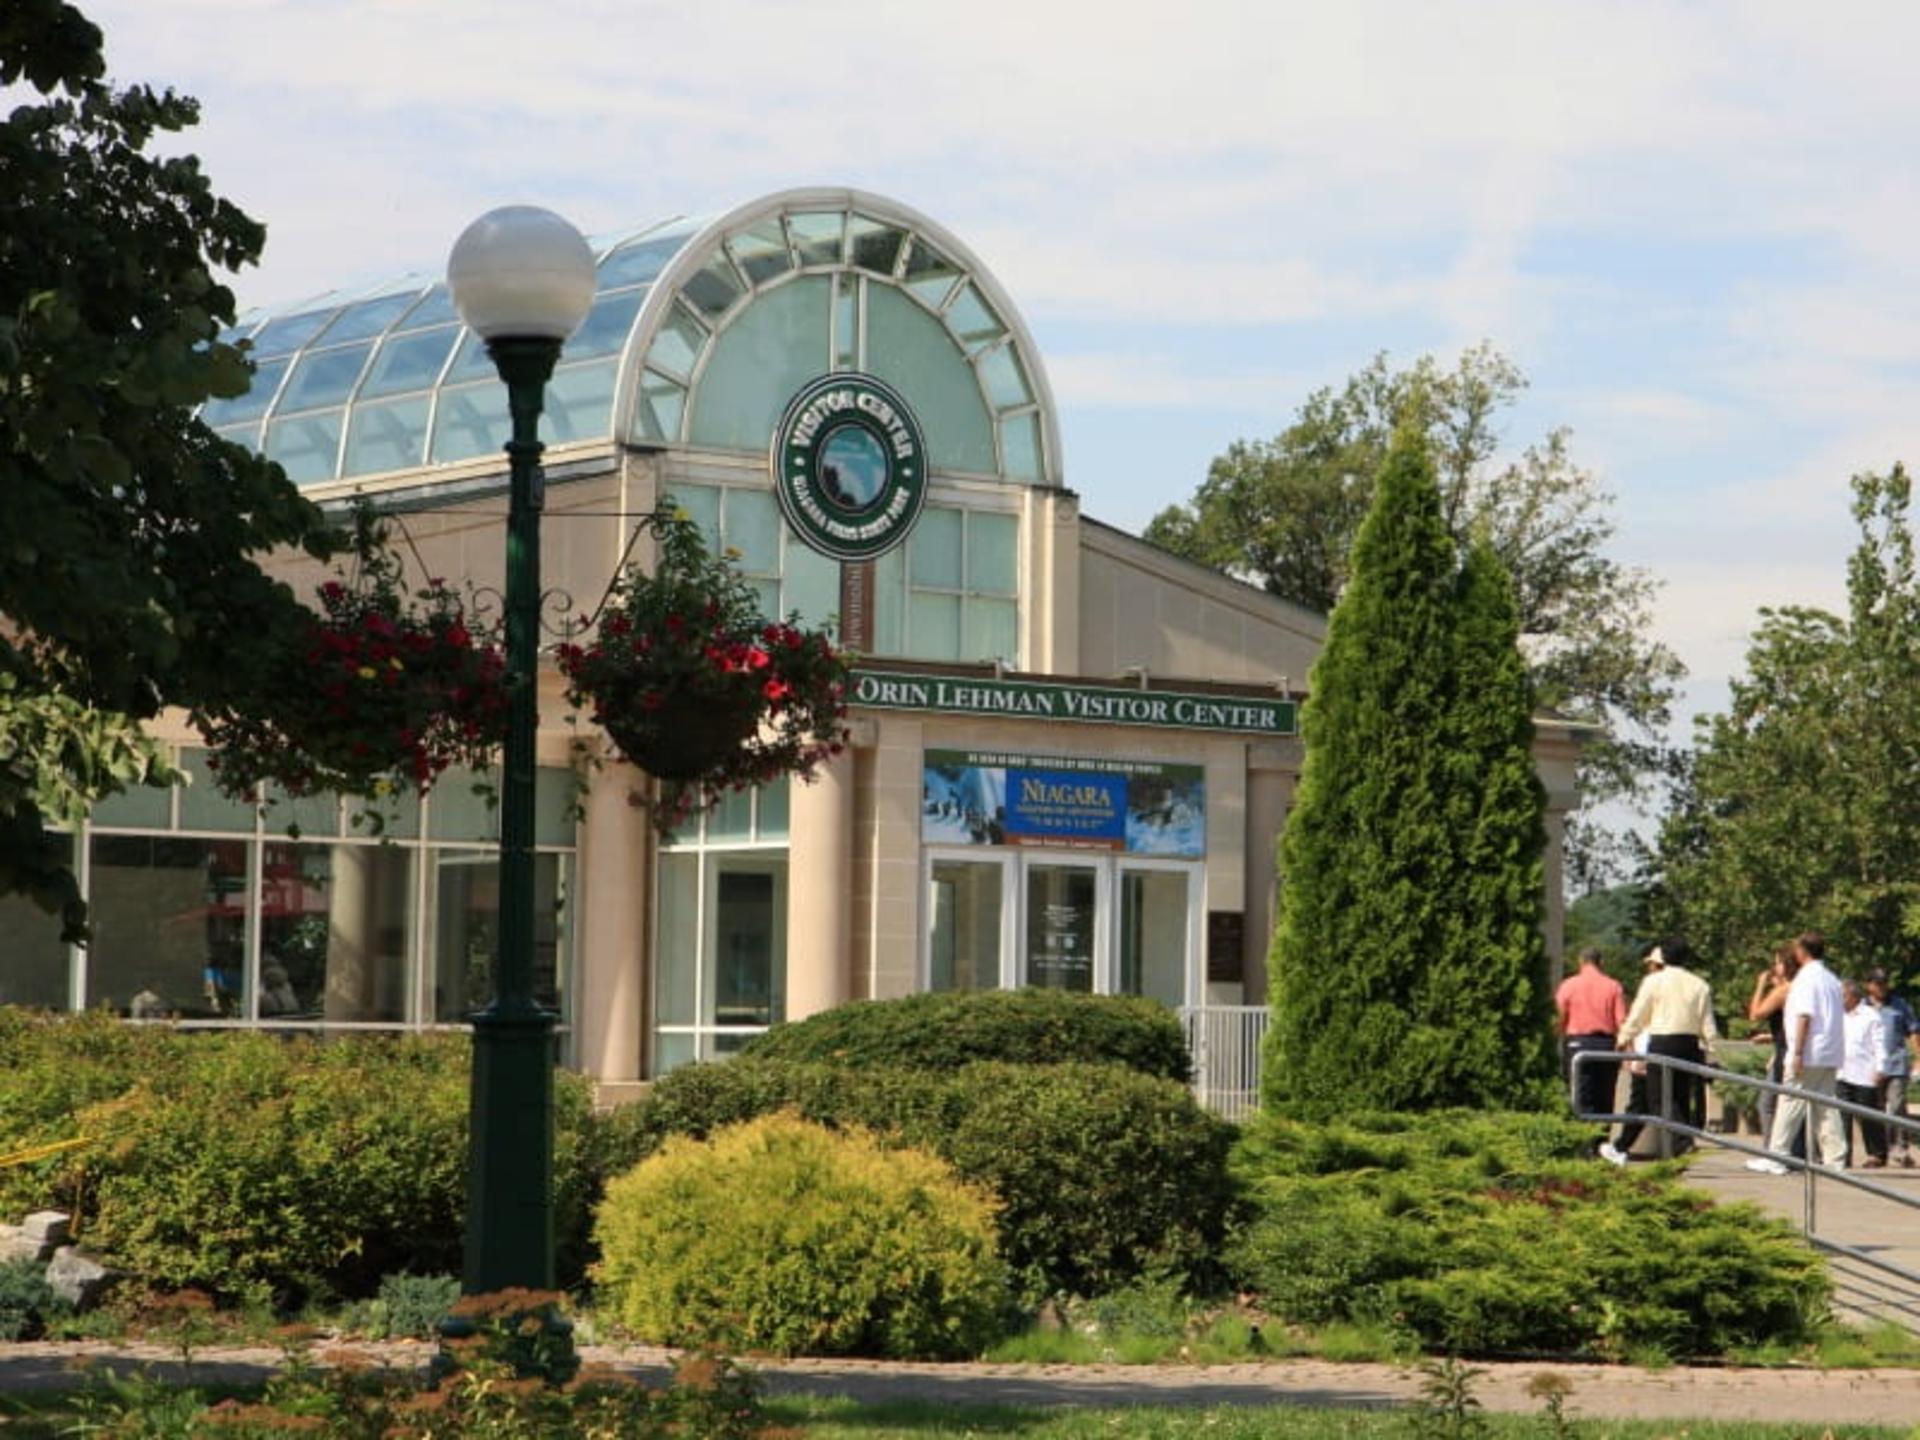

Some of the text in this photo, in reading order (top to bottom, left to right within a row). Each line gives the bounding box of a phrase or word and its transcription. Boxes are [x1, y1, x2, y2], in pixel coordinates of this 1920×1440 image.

[791, 390, 913, 459] VISITOR CENTER
[856, 676, 1277, 728] ORIN LEHMAN VISITOR CENTER
[1021, 778, 1111, 807] NIAGARA
